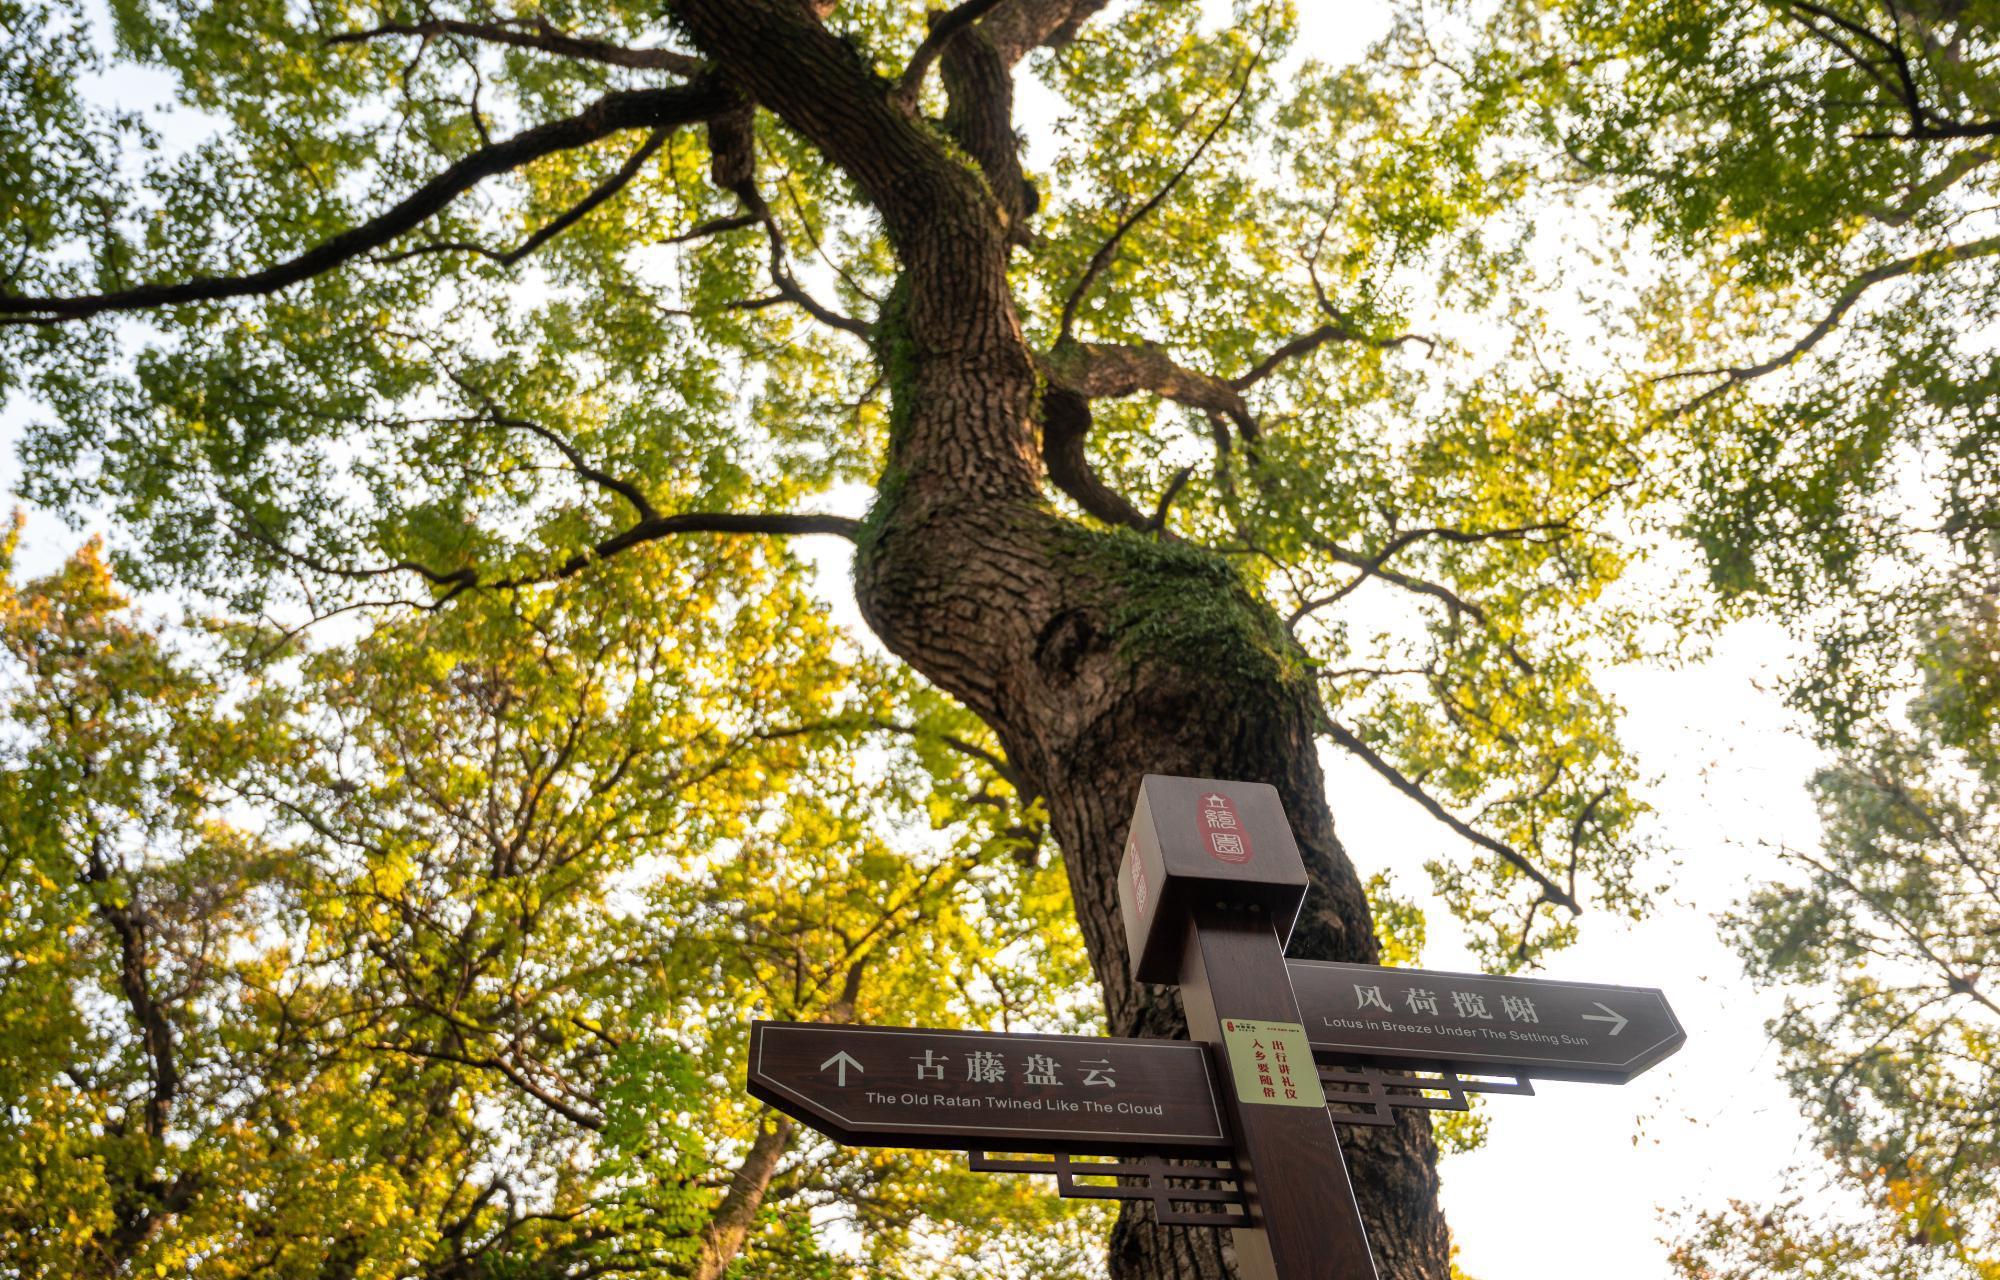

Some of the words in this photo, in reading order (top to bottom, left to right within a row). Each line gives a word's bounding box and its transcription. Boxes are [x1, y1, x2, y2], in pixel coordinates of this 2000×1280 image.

[1353, 984, 1539, 1024] 风荷揽榭
[1323, 1017, 1364, 1029] Lotus
[1366, 1021, 1379, 1030] in
[1381, 1021, 1432, 1034] Breeze
[1434, 1025, 1477, 1038] Under
[1479, 1028, 1507, 1040] The
[1509, 1030, 1560, 1046] Setting
[1561, 1034, 1589, 1046] Sun
[909, 1049, 1116, 1088] 古藤盘云
[1252, 1039, 1276, 1098] 入乡要随俗
[1271, 1040, 1298, 1100] 出行讲礼仪
[865, 1092, 897, 1104] The
[900, 1093, 929, 1105] Old
[933, 1094, 981, 1108] Ratan
[984, 1096, 1042, 1110] Twined
[1046, 1099, 1079, 1112] Like
[1082, 1101, 1113, 1113] The
[1117, 1102, 1163, 1116] Cloud
